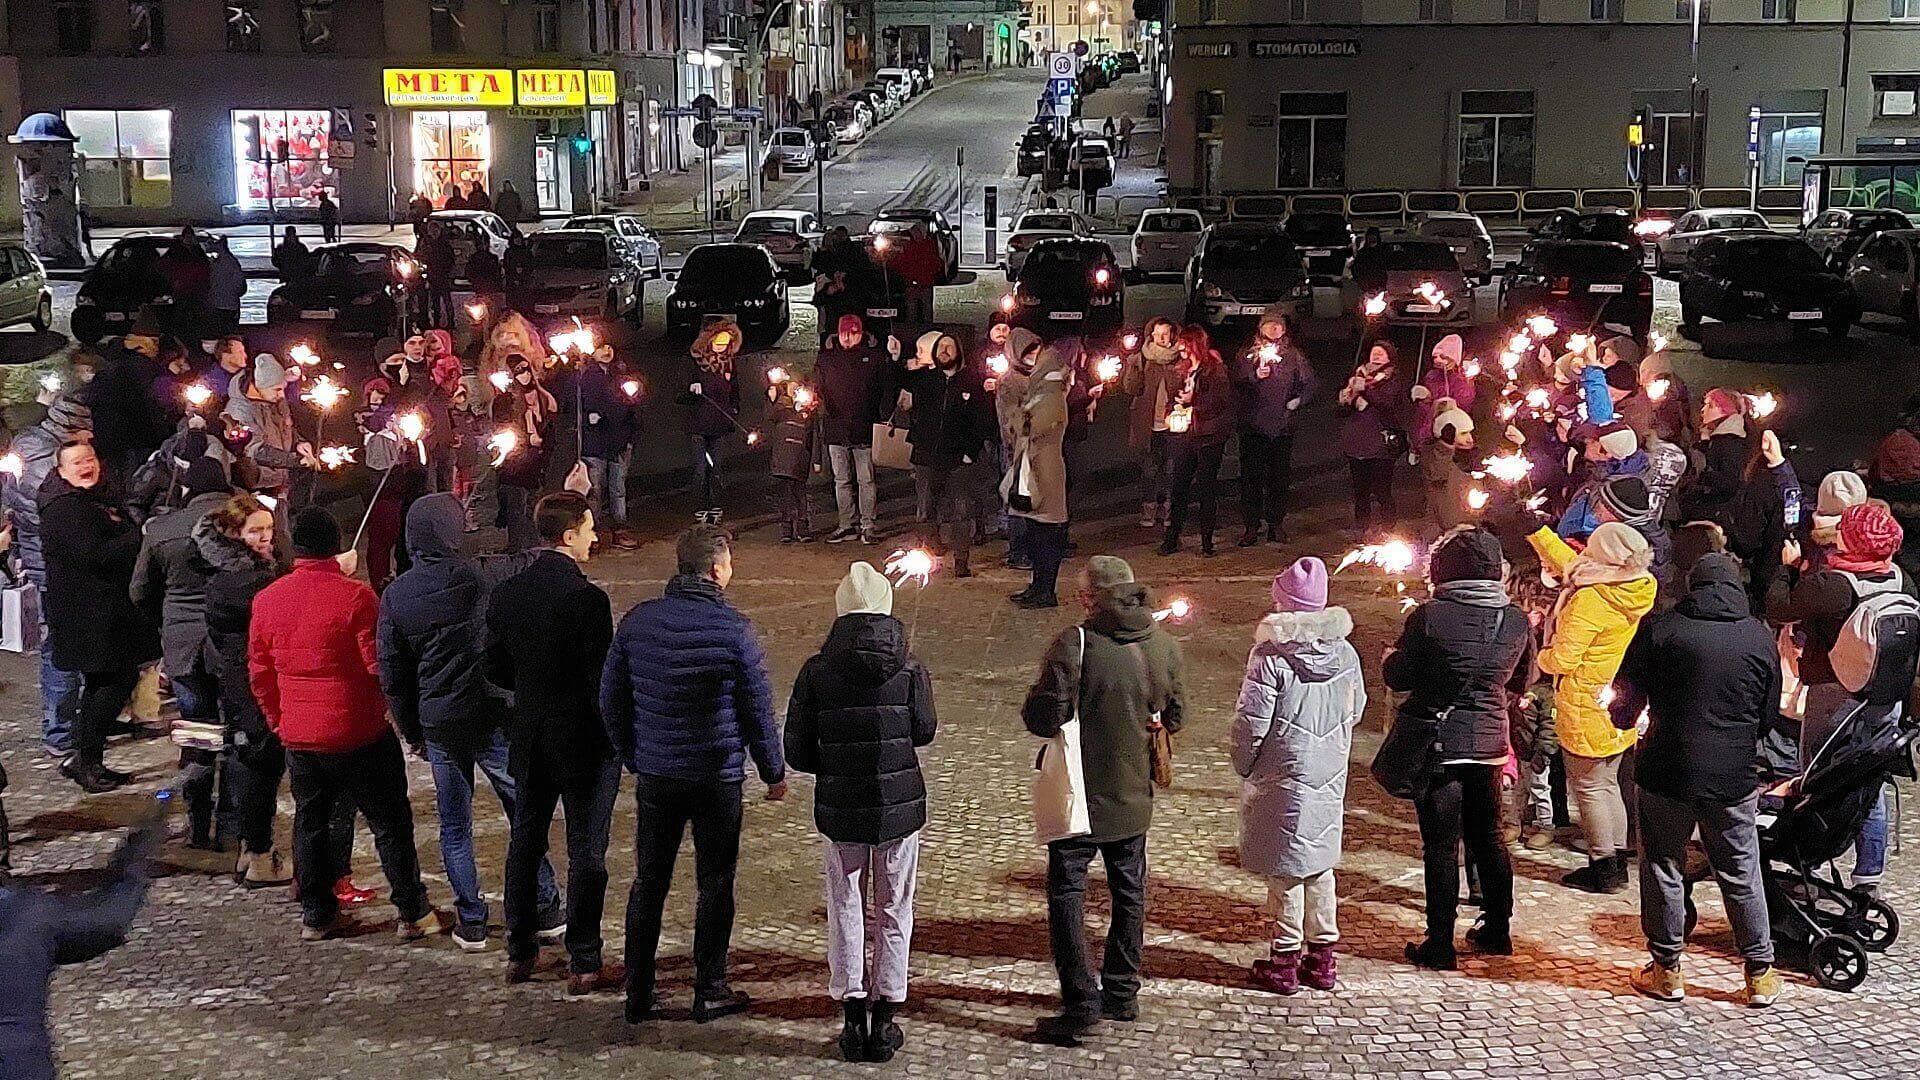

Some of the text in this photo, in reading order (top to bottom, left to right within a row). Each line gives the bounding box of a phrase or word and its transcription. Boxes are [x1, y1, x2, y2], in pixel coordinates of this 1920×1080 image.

[1188, 43, 1231, 56] WERNER
[1255, 43, 1357, 55] STOMATOLOGIA
[1057, 61, 1069, 70] 30
[396, 73, 501, 93] META
[521, 73, 581, 93] META
[590, 74, 613, 93] META
[1057, 80, 1068, 94] P
